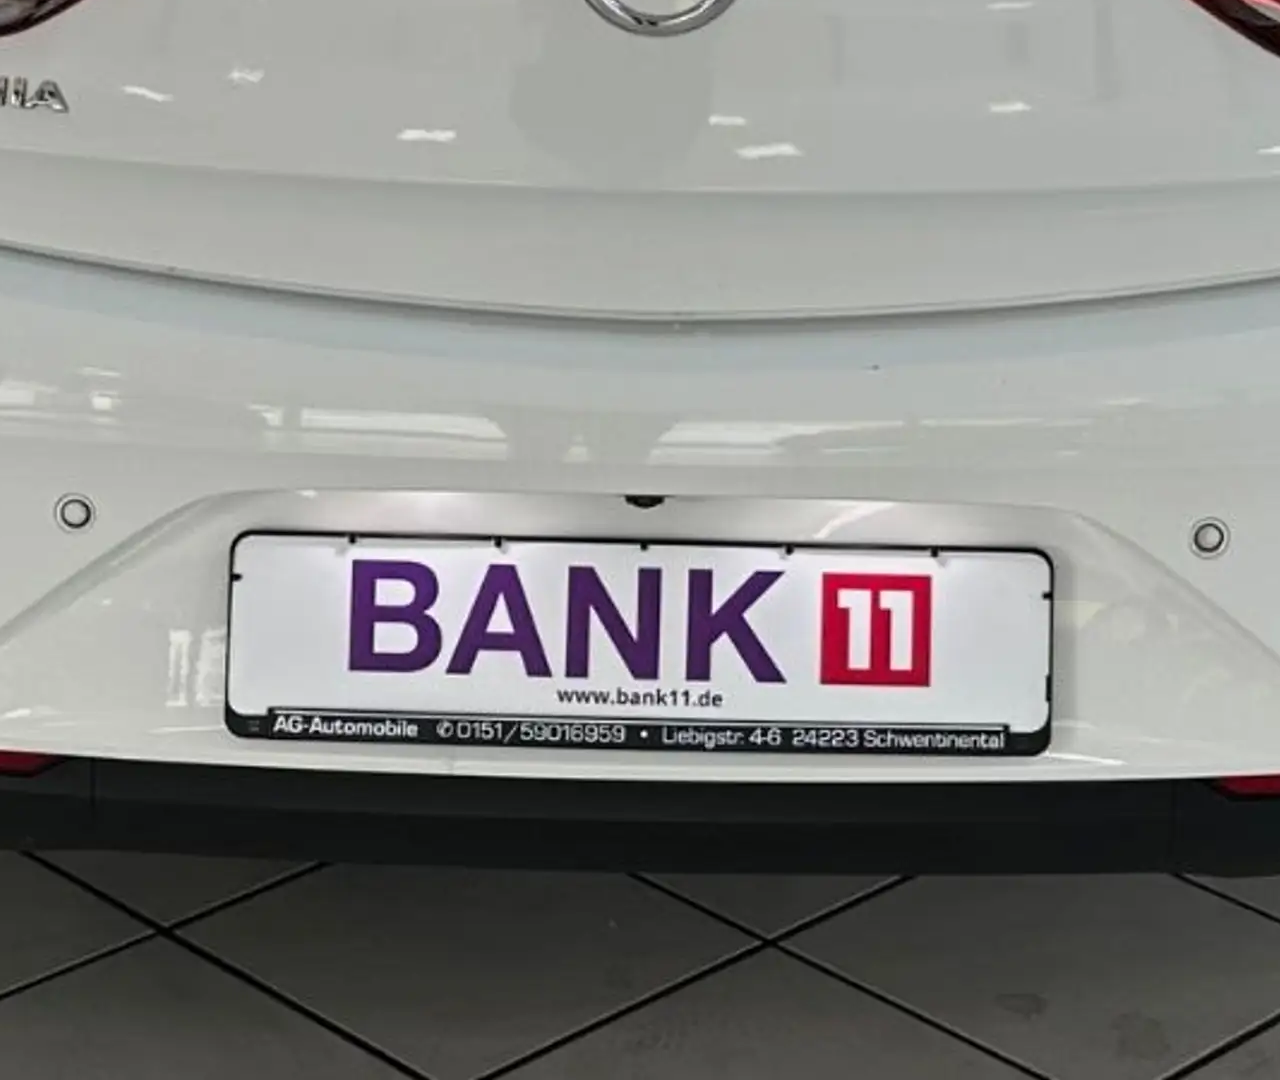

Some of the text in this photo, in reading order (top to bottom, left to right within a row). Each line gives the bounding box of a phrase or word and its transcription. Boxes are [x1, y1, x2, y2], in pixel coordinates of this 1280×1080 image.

[349, 559, 915, 684] BANK 11
[557, 687, 724, 709] www.bank11.de
[273, 717, 419, 738] AG-Automobile
[749, 727, 782, 747] 4-6
[792, 729, 859, 748] 24223
[863, 731, 1005, 750] Schwentinental
